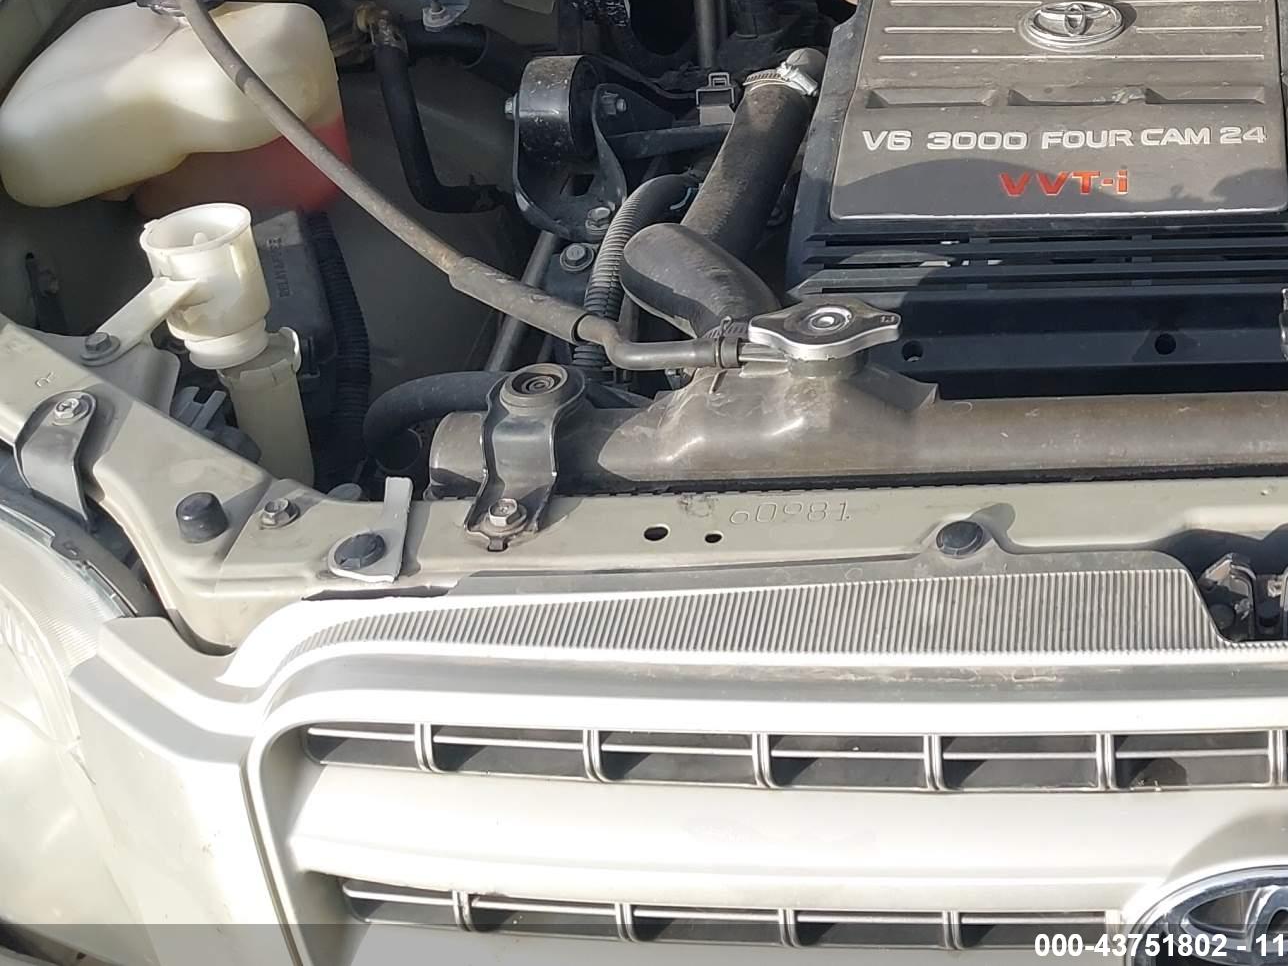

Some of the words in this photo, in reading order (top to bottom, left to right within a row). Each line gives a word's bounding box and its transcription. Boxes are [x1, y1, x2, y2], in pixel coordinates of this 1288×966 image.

[862, 130, 912, 151] V6
[926, 130, 1028, 150] 3000
[1041, 129, 1133, 150] FOUR
[1140, 127, 1211, 146] CAM
[1219, 126, 1267, 144] 24
[998, 169, 1130, 198] VVT-i
